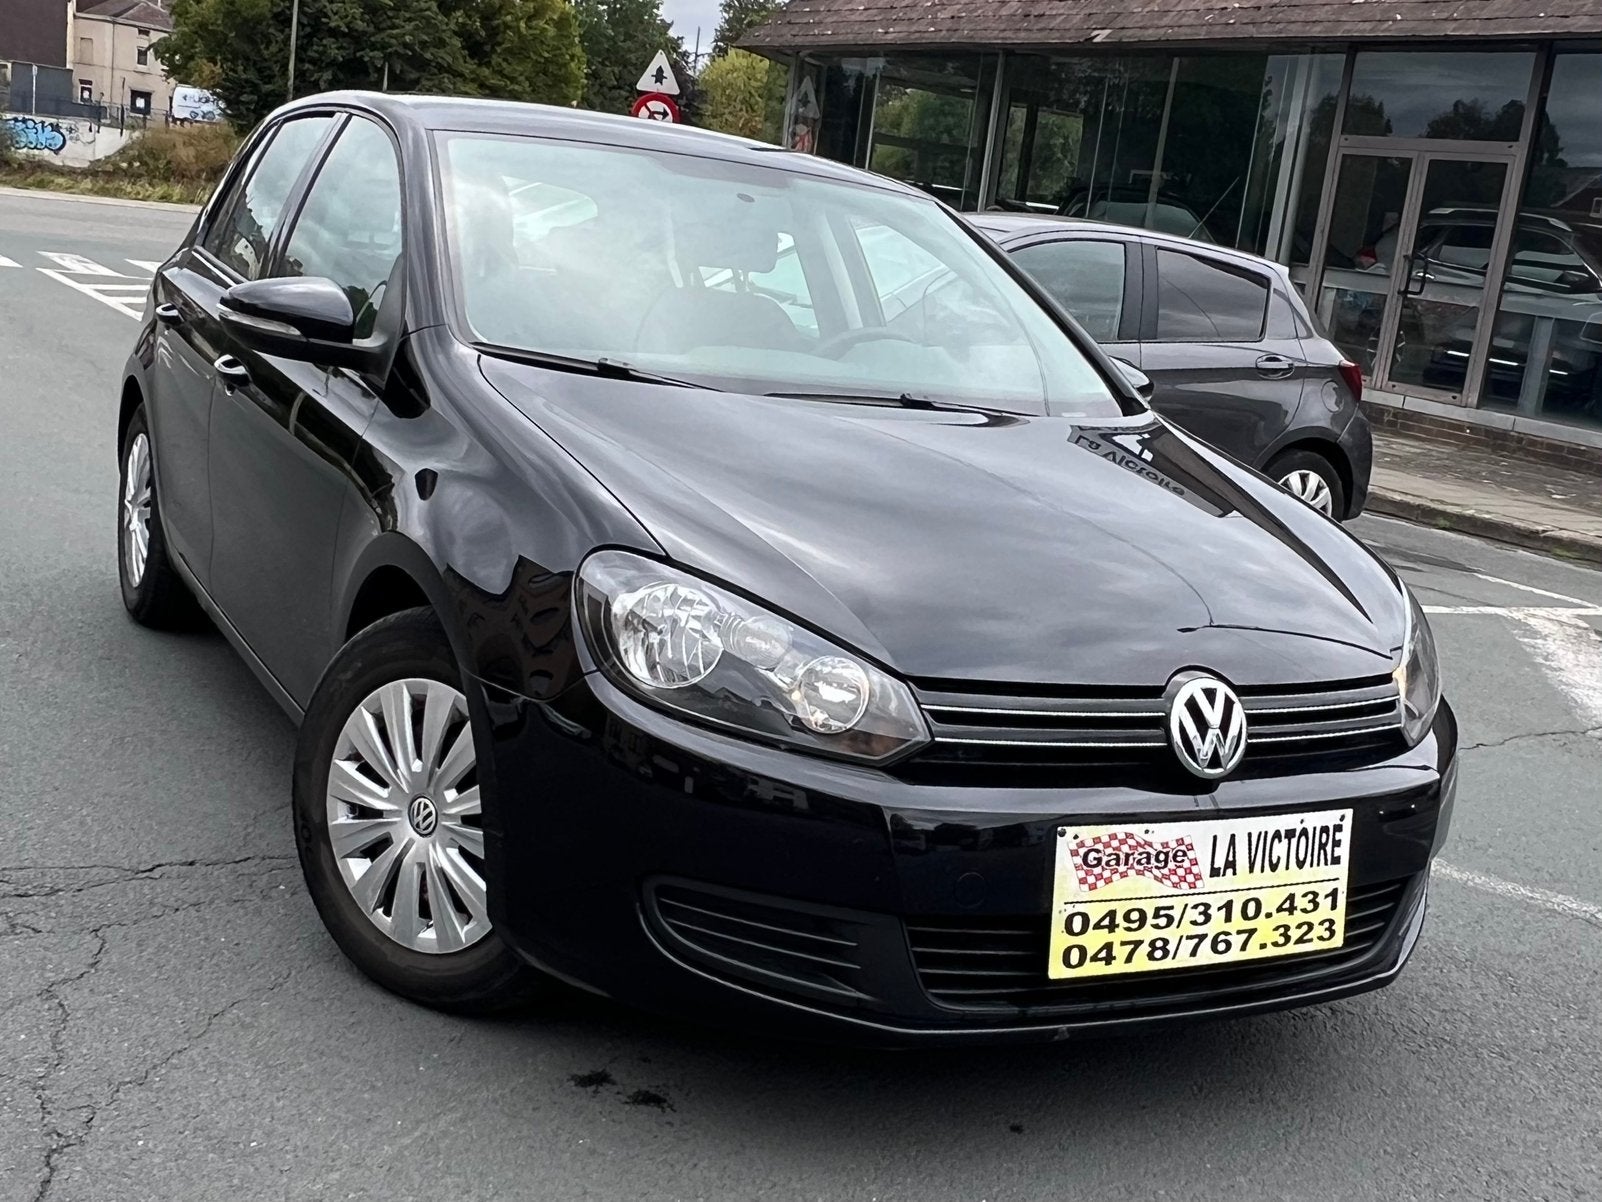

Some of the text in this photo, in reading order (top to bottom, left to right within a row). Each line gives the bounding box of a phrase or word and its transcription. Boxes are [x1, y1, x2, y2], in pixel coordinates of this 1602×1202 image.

[1172, 679, 1246, 776] VW
[1081, 823, 1343, 878] Garage LA VICTOIRE
[1064, 887, 1339, 937] 0495/310.431
[1061, 917, 1336, 969] 0478/767.323
